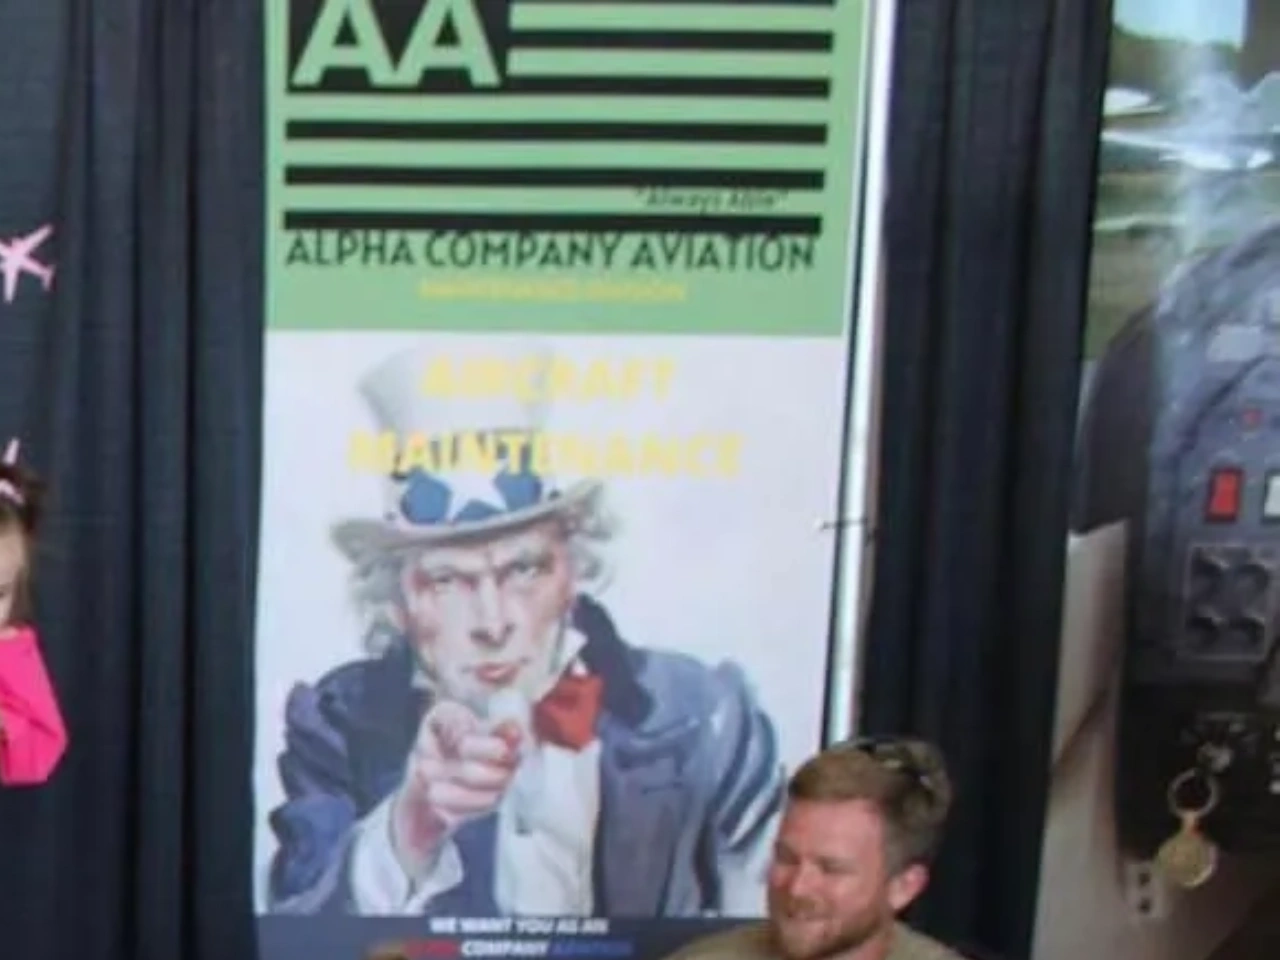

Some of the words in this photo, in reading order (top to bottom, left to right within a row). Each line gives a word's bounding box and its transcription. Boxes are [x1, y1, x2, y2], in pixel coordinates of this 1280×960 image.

[291, 0, 503, 87] AA
[286, 229, 415, 266] ALPHA
[424, 231, 620, 270] COMPANY
[631, 234, 815, 271] AVIATION
[425, 354, 677, 399] AIRCRAFT
[348, 429, 745, 476] MAINTENANCE
[461, 940, 549, 956] COMPANY
